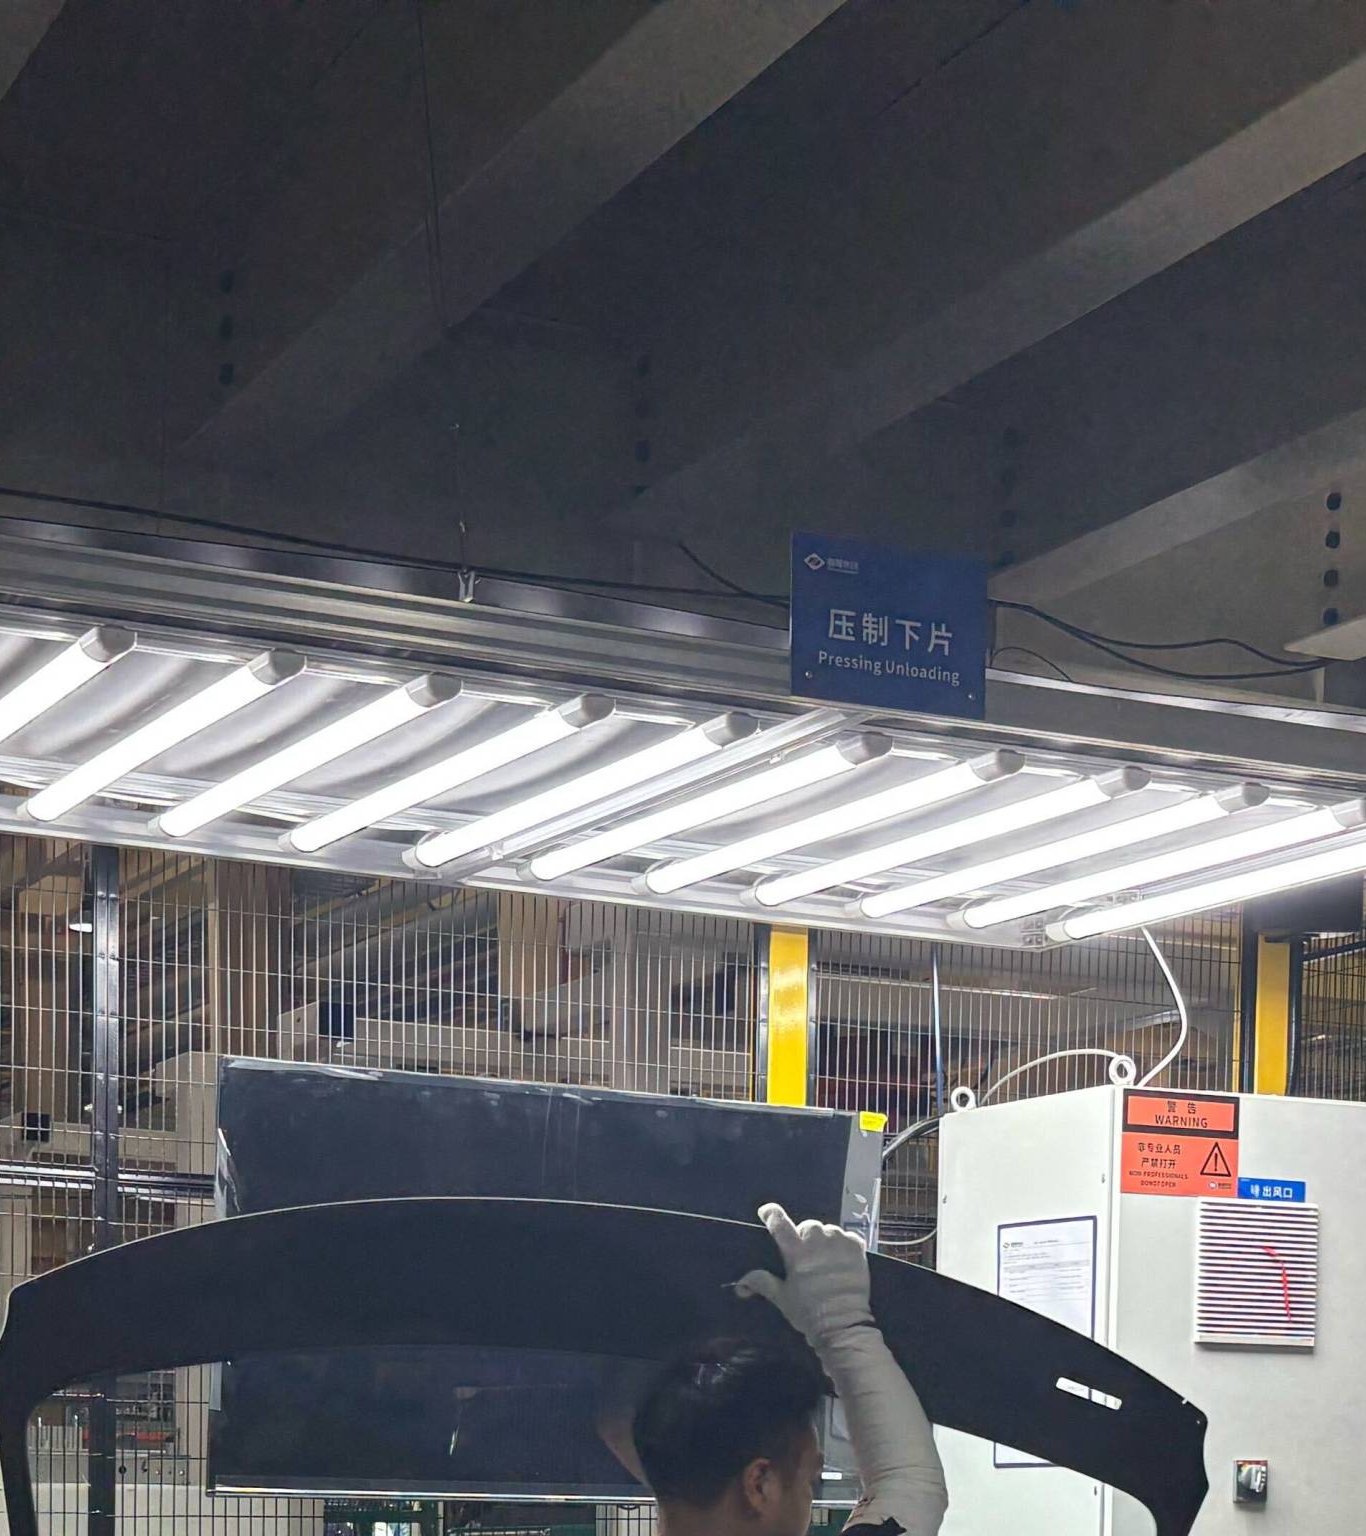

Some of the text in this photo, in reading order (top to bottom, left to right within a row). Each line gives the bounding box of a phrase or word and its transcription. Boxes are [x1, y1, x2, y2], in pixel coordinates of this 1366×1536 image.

[828, 608, 953, 656] 压制下片
[818, 650, 960, 687] Pressing Unloading
[1167, 1100, 1196, 1115] 警告
[1155, 1114, 1208, 1129] WARNING
[1138, 1142, 1181, 1155] 非专业人员
[1141, 1157, 1176, 1168] 严禁打开
[1262, 1185, 1293, 1198] 出风口
